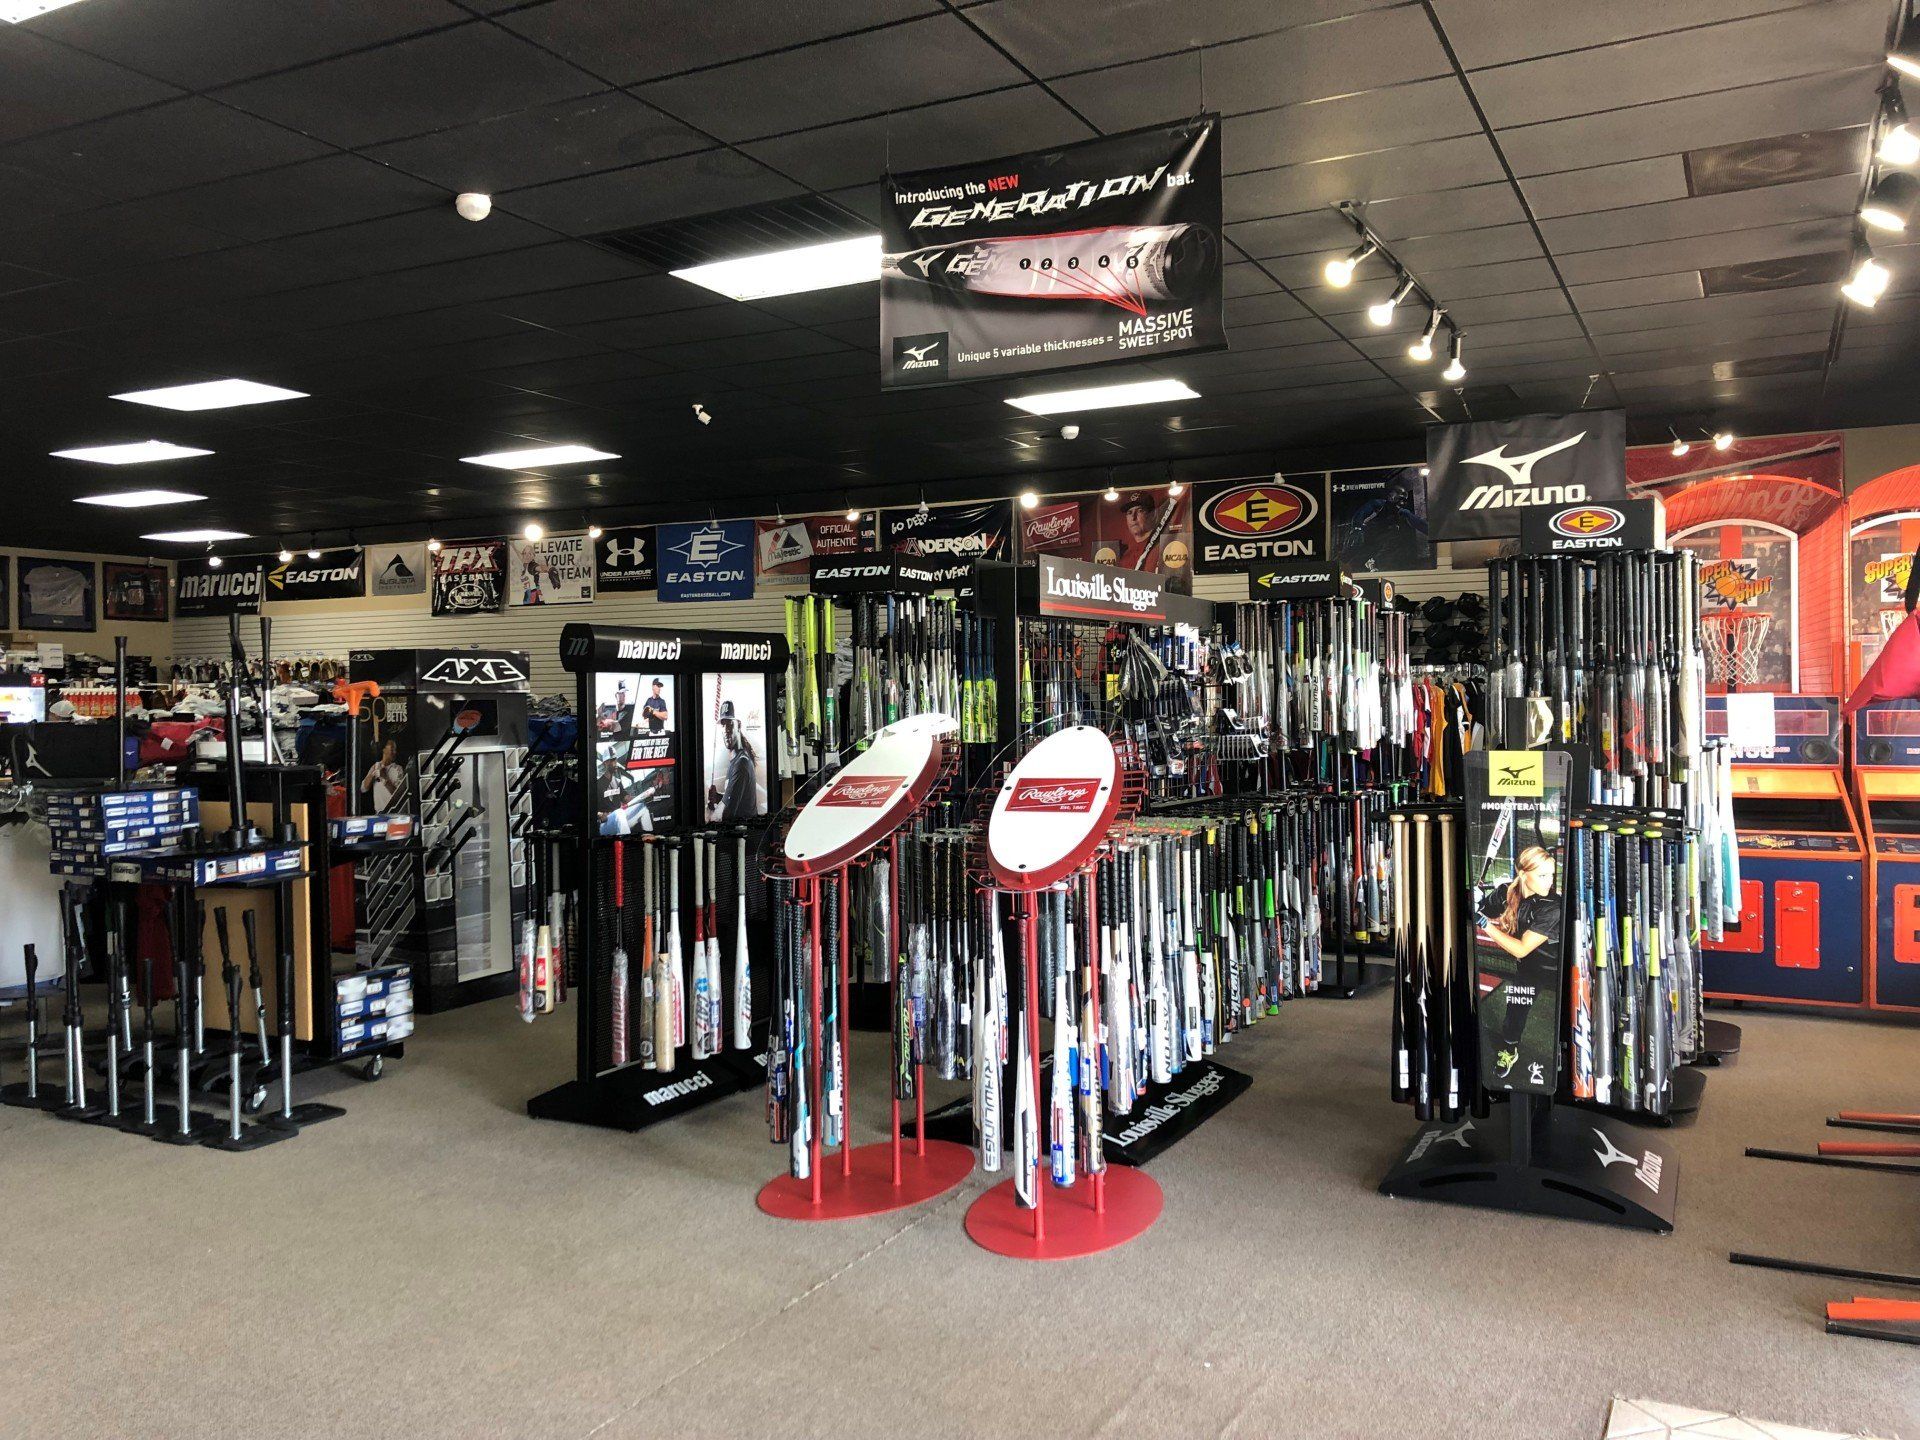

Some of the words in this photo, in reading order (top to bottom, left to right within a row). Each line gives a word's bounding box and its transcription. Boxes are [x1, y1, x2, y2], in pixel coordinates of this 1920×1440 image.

[895, 182, 964, 205] Introducing
[966, 180, 986, 196] the
[988, 174, 1019, 192] NEW
[908, 163, 1170, 230] GENERATION
[1166, 170, 1195, 188] bat.
[1118, 308, 1193, 337] MASSIVE
[957, 348, 991, 363] Unique
[993, 348, 1000, 358] 5
[1001, 341, 1042, 358] variable
[1043, 334, 1105, 353] thicknesses
[1118, 331, 1160, 350] SWEET
[1162, 325, 1193, 346] SPOT
[1246, 498, 1270, 523] E
[1579, 515, 1594, 528] E
[820, 524, 853, 535] OFFICIAL
[891, 522, 905, 535] GO
[1026, 515, 1076, 538] Rawlings
[533, 539, 583, 554] ELEVATE
[690, 535, 724, 561] E
[816, 537, 858, 548] AUTHENTIC
[904, 532, 987, 558] ANDERSON
[1204, 540, 1314, 562] EASTON
[1552, 536, 1623, 550] EASTON
[436, 545, 497, 572] TPX
[543, 553, 575, 567] YOUR
[1864, 554, 1912, 584] SUPER
[179, 565, 262, 598] marucci
[285, 566, 359, 584] EASTON
[560, 567, 592, 580] TEAM
[623, 569, 652, 577] ARMOUR
[666, 570, 744, 583] EASTON
[815, 565, 891, 579] EASTON
[900, 566, 933, 582] EASTON
[944, 564, 970, 580] VERY
[1271, 573, 1331, 584] EASTON
[1699, 560, 1731, 585] UPER
[1046, 566, 1113, 602] Louisville
[1113, 576, 1160, 611] Slugger
[1736, 576, 1773, 603] SHOT
[617, 637, 682, 661] marucci
[720, 640, 772, 661] marucci
[421, 658, 527, 685] AXE
[1312, 675, 1320, 729] RAWLINGS
[386, 711, 408, 723] BETTS
[630, 746, 643, 760] FOR
[643, 746, 655, 759] THE
[653, 745, 669, 758] BEST
[832, 783, 891, 799] Rawlings
[1018, 781, 1088, 804] Rawlings
[1504, 985, 1536, 996] JENNIE
[1505, 995, 1534, 1006] FINCH
[642, 1070, 714, 1107] marucci
[1102, 1102, 1175, 1149] Louisville
[1163, 1068, 1226, 1111] Slugger
